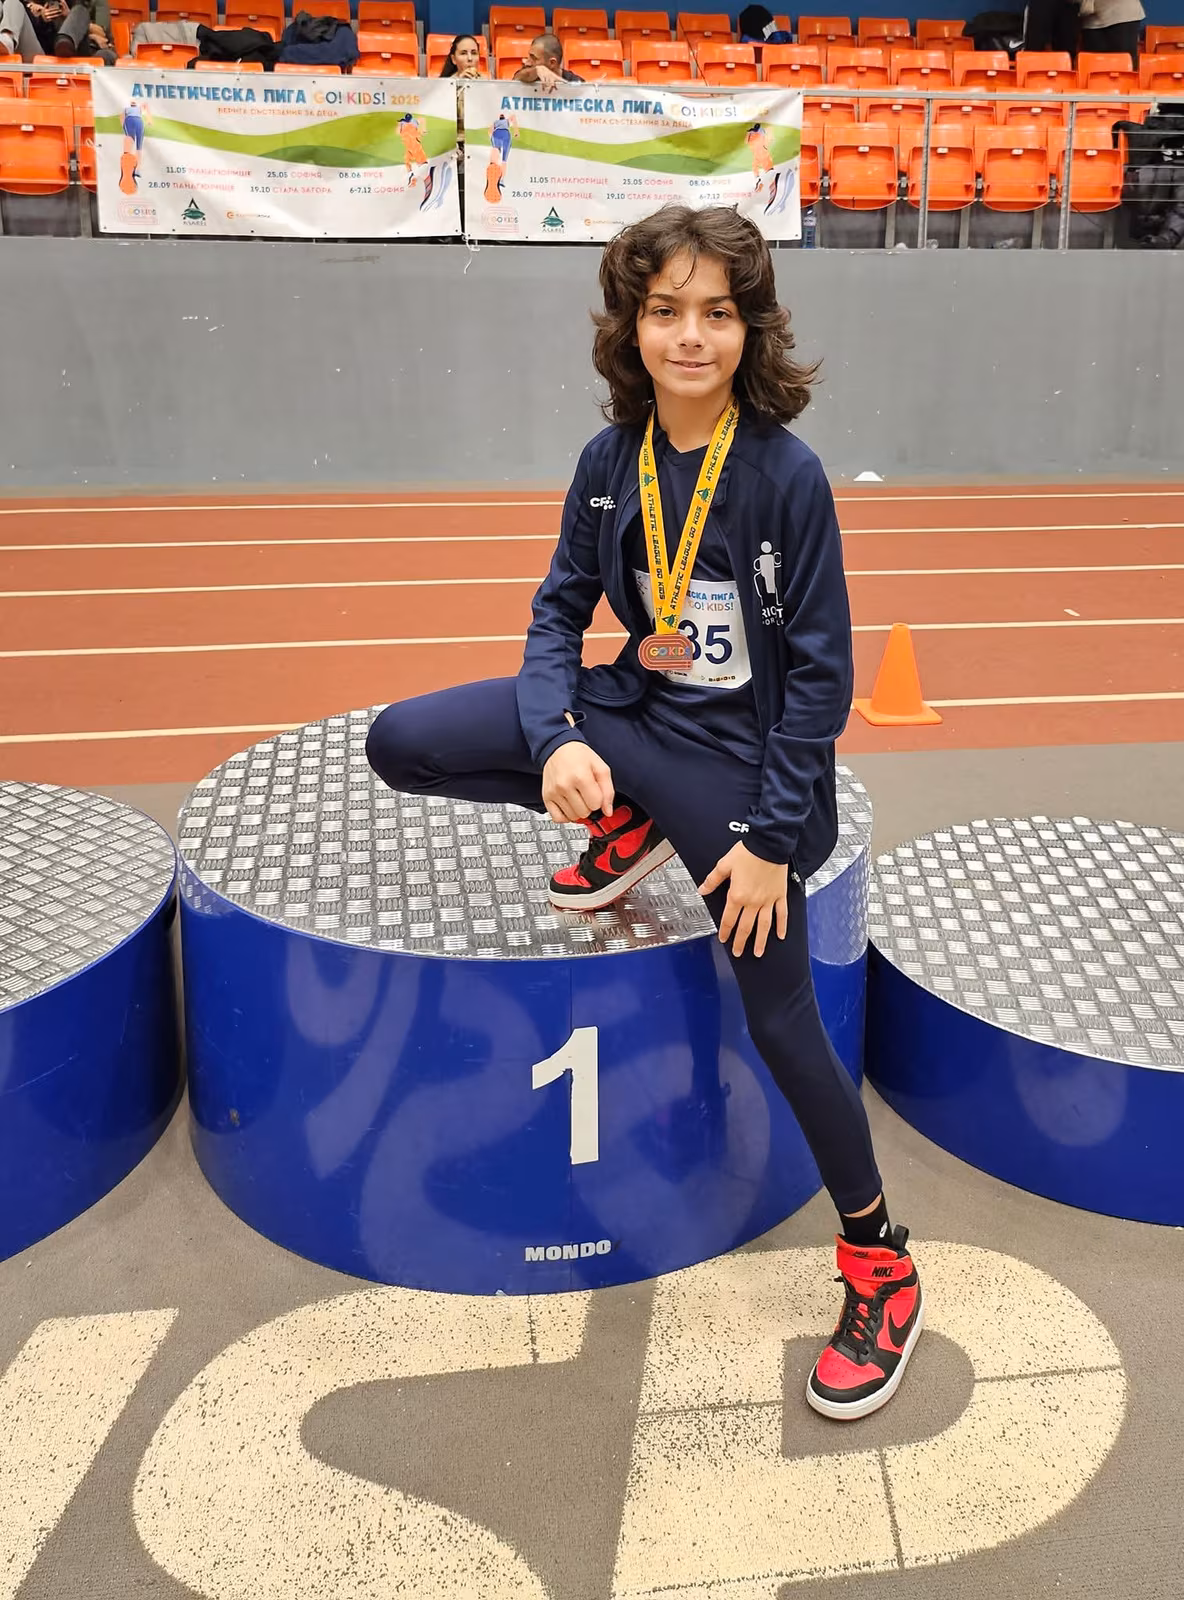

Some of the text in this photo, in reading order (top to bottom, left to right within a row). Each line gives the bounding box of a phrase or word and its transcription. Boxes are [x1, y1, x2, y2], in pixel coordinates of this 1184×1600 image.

[132, 83, 420, 106] АТЛЕТИЧЕСКА ЛИГА GO! KIDS! 2025
[501, 96, 615, 113] АТЛЕТИЧЕСКА
[623, 100, 664, 114] ЛИГА
[706, 442, 724, 481] ATHLETIC
[648, 492, 658, 532] ATHLETIC
[652, 534, 662, 566] LEAGUE
[670, 572, 684, 610] ATHLETIC
[680, 540, 692, 571] LEAGUE
[694, 506, 702, 525] KIDS
[656, 568, 662, 578] GO
[707, 602, 734, 612] KIDS!
[711, 592, 735, 600] ЛИГА
[652, 618, 733, 664] 35
[532, 1026, 599, 1165] 1
[525, 1240, 612, 1262] MONDO
[872, 1266, 895, 1278] NIKE
